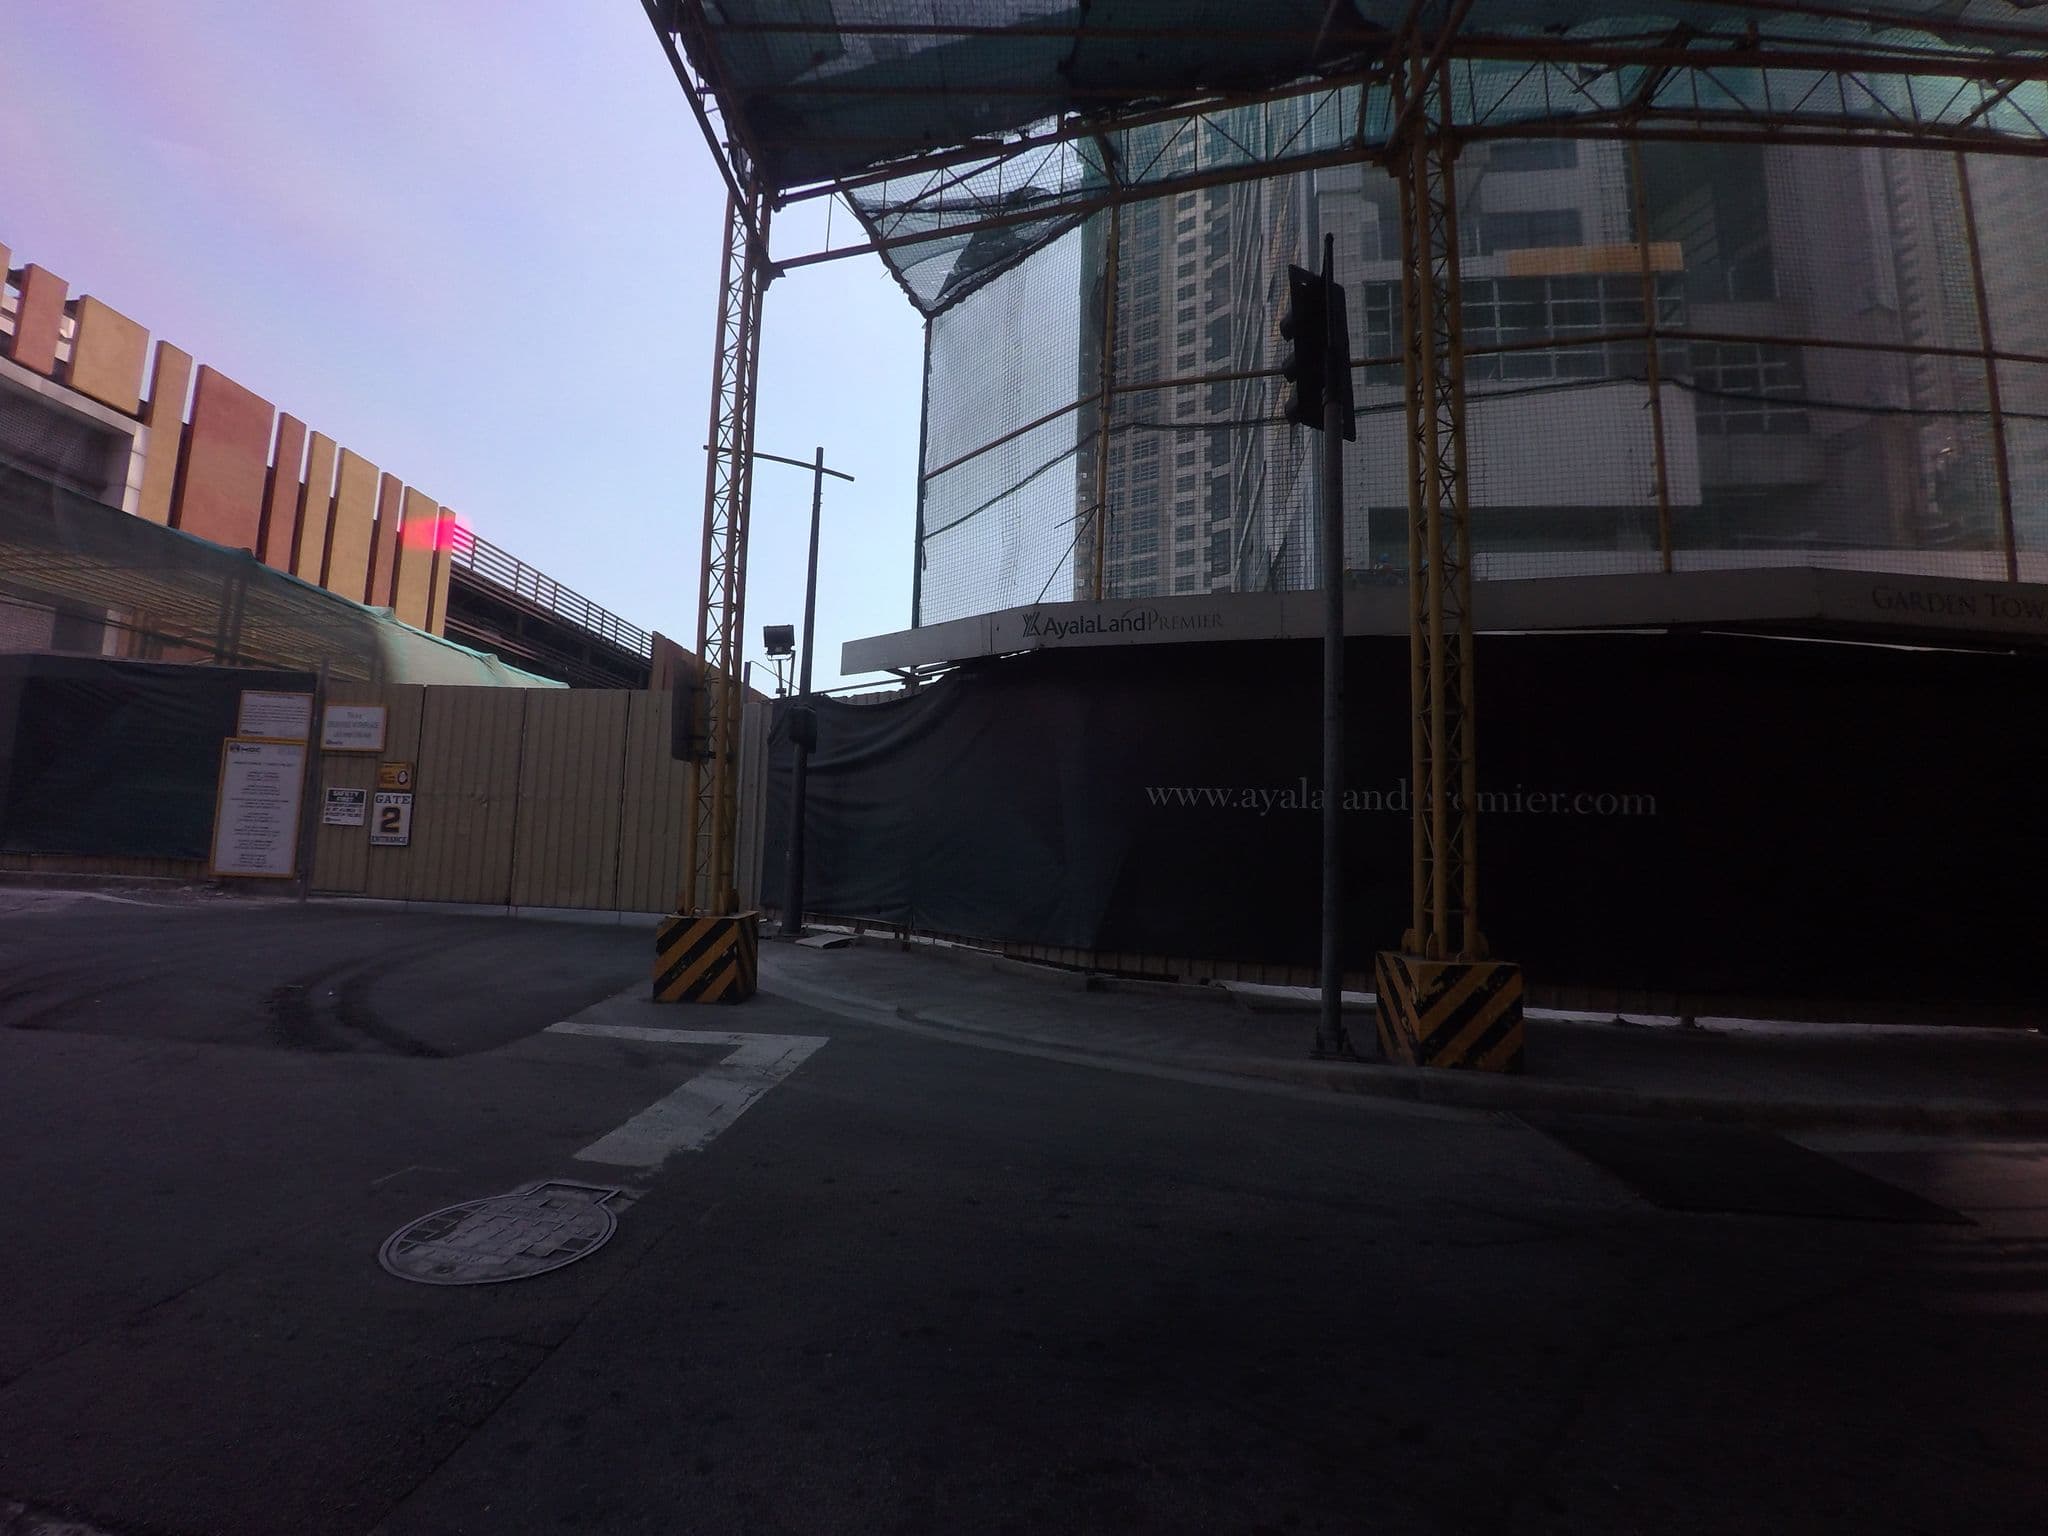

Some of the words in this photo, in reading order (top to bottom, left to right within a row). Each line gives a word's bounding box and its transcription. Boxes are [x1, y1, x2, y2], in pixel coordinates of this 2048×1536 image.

[1043, 609, 1146, 639] AyalaLand
[1148, 609, 1224, 633] PREMIER
[375, 795, 410, 804] GATE
[1144, 777, 1658, 818] www.ayalaandemier.com
[381, 807, 400, 833] 2
